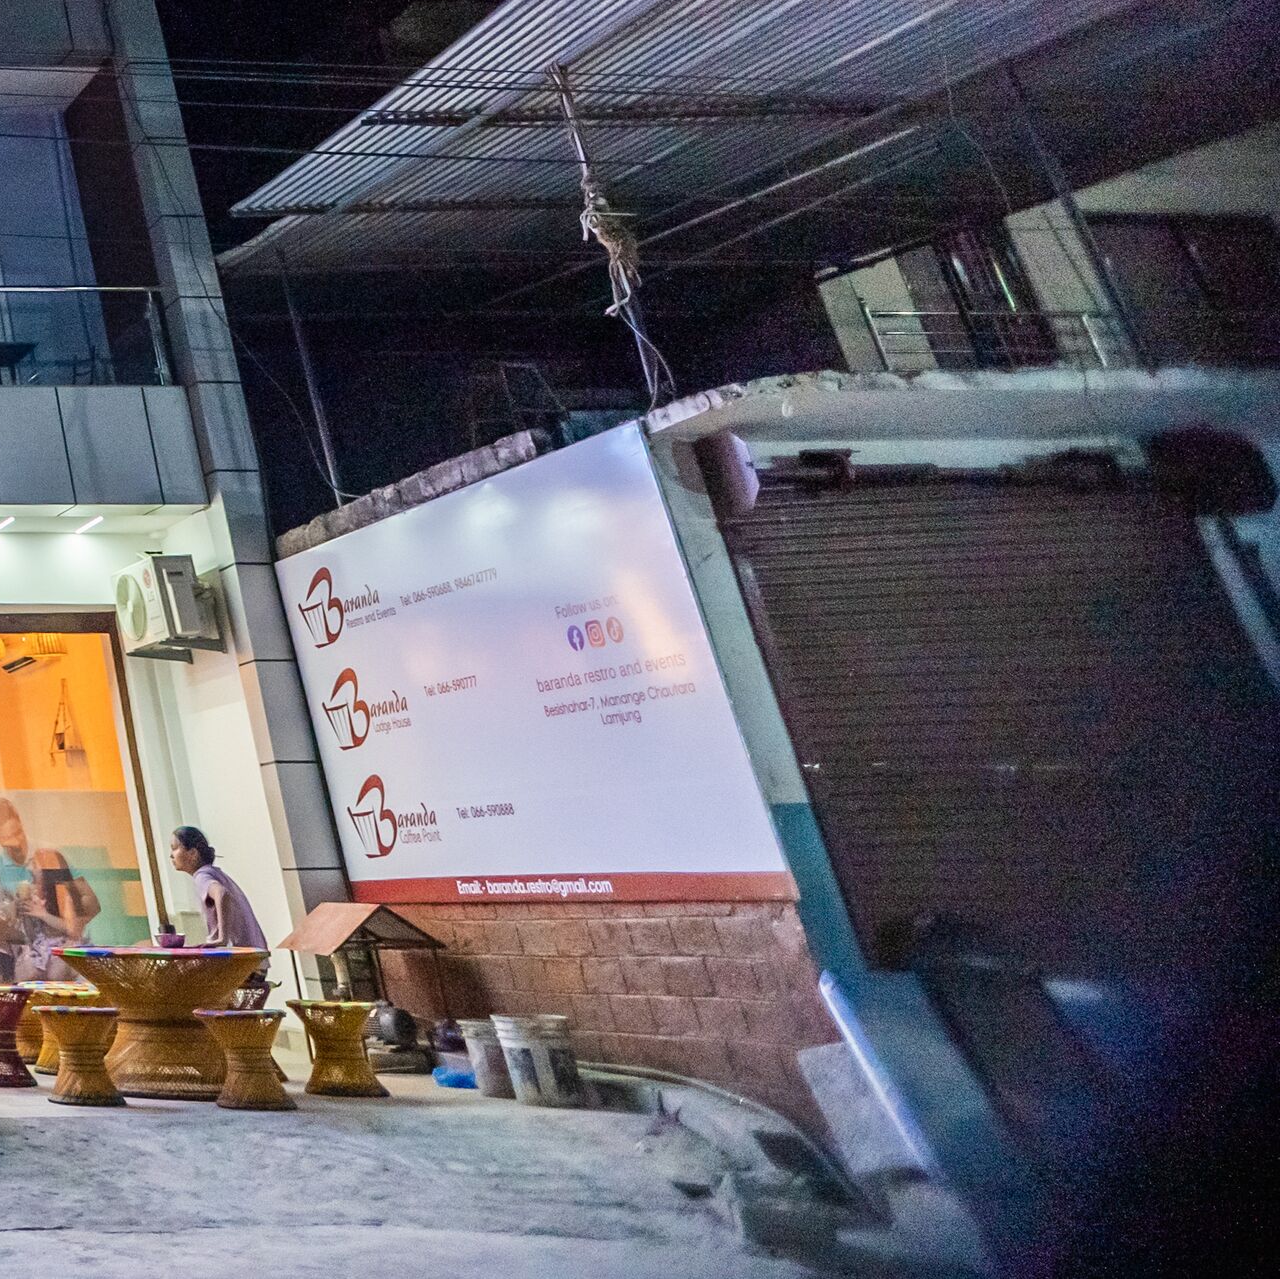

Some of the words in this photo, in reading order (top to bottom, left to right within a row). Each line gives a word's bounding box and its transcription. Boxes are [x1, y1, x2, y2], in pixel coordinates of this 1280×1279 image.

[298, 566, 380, 649] Baranda
[376, 606, 397, 621] Events
[554, 601, 587, 619] Follow
[589, 599, 601, 611] us
[536, 672, 582, 693] baranda
[584, 666, 617, 684] restro
[619, 659, 642, 677] and
[644, 653, 686, 672] events
[600, 689, 646, 708] Manange
[646, 681, 696, 701] Chautara
[321, 667, 409, 751] Baranda
[600, 709, 643, 726] Lamjung
[346, 773, 438, 859] Baranda
[399, 829, 421, 845] Coffee
[422, 828, 443, 843] Point
